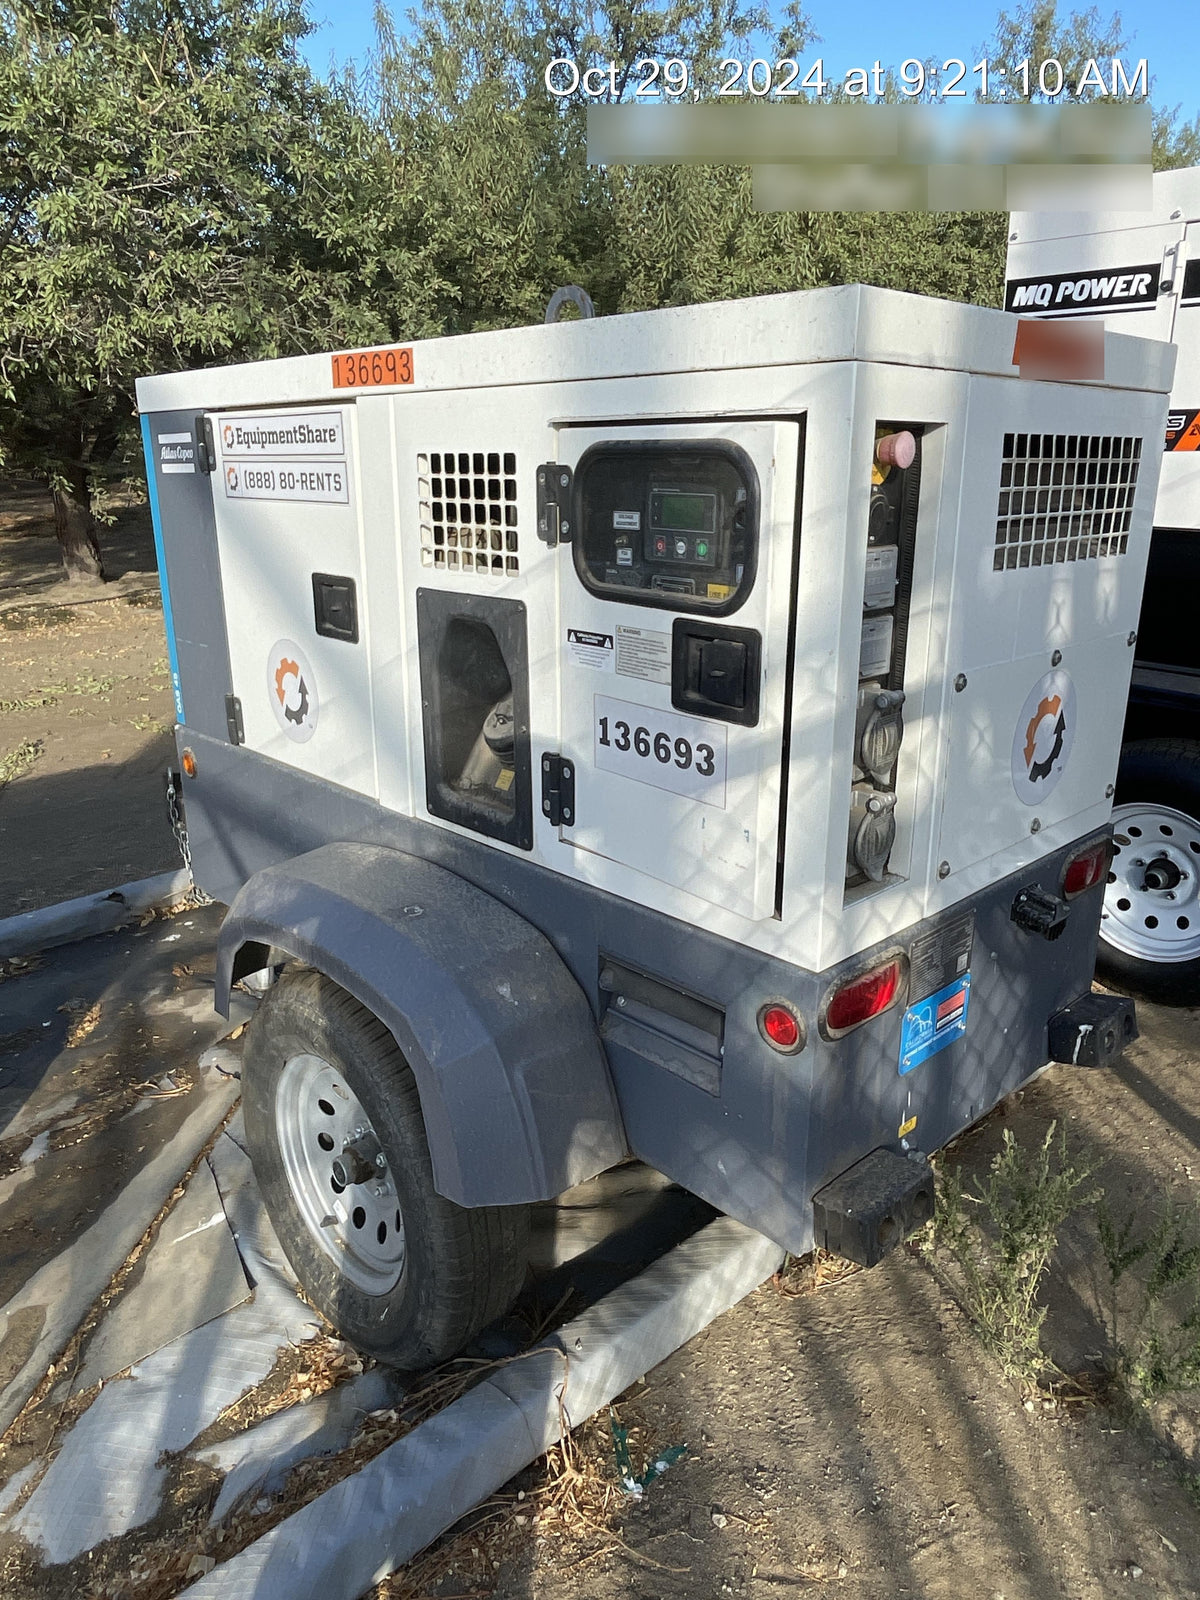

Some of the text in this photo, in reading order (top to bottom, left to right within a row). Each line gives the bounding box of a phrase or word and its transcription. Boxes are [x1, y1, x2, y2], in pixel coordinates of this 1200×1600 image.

[1012, 273, 1152, 307] MQ POWER
[333, 350, 411, 386] 136693
[235, 424, 337, 449] EquipmentShare
[160, 446, 194, 461] Atlas Copco
[244, 470, 342, 492] (888) 80-RENTS
[598, 716, 715, 777] 136693
